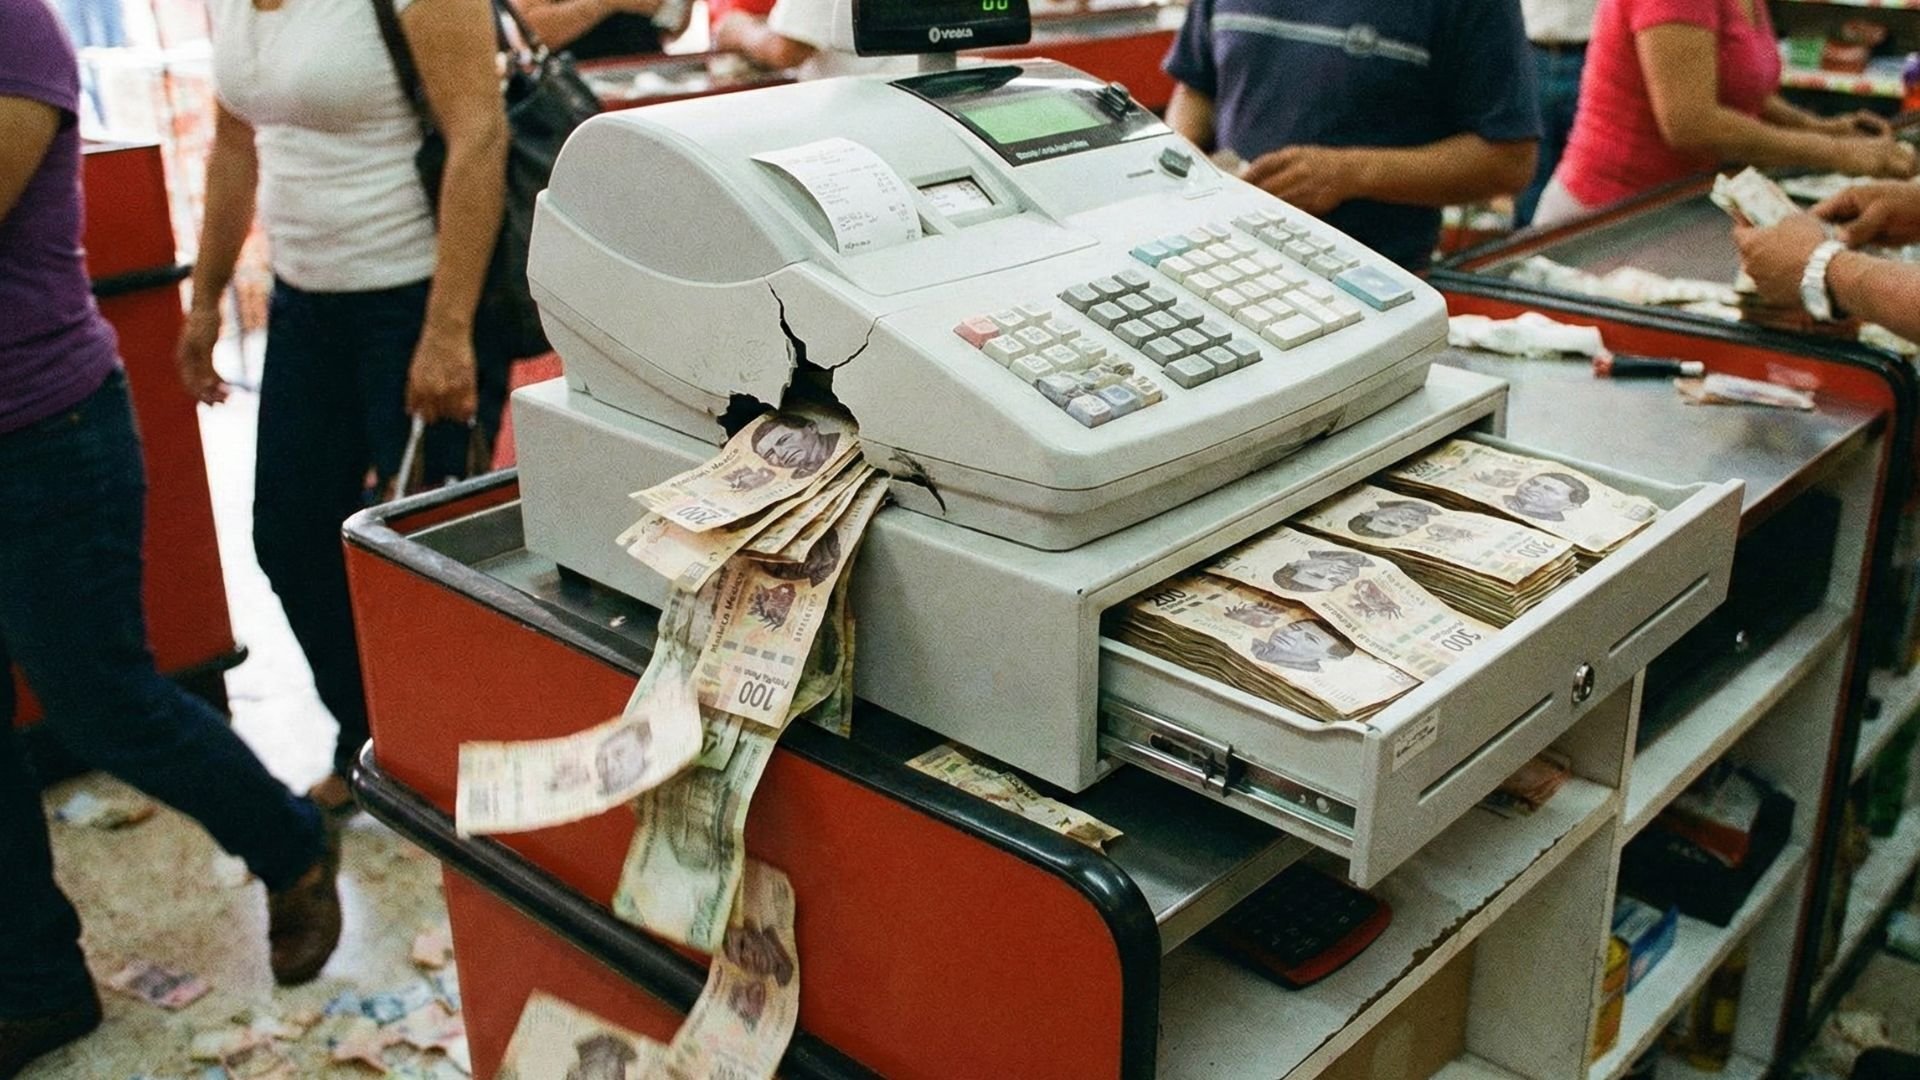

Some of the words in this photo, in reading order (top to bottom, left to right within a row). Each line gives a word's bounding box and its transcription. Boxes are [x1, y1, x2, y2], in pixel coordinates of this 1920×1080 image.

[1147, 588, 1186, 607] 200
[1441, 629, 1481, 651] 500
[738, 681, 776, 711] 100
